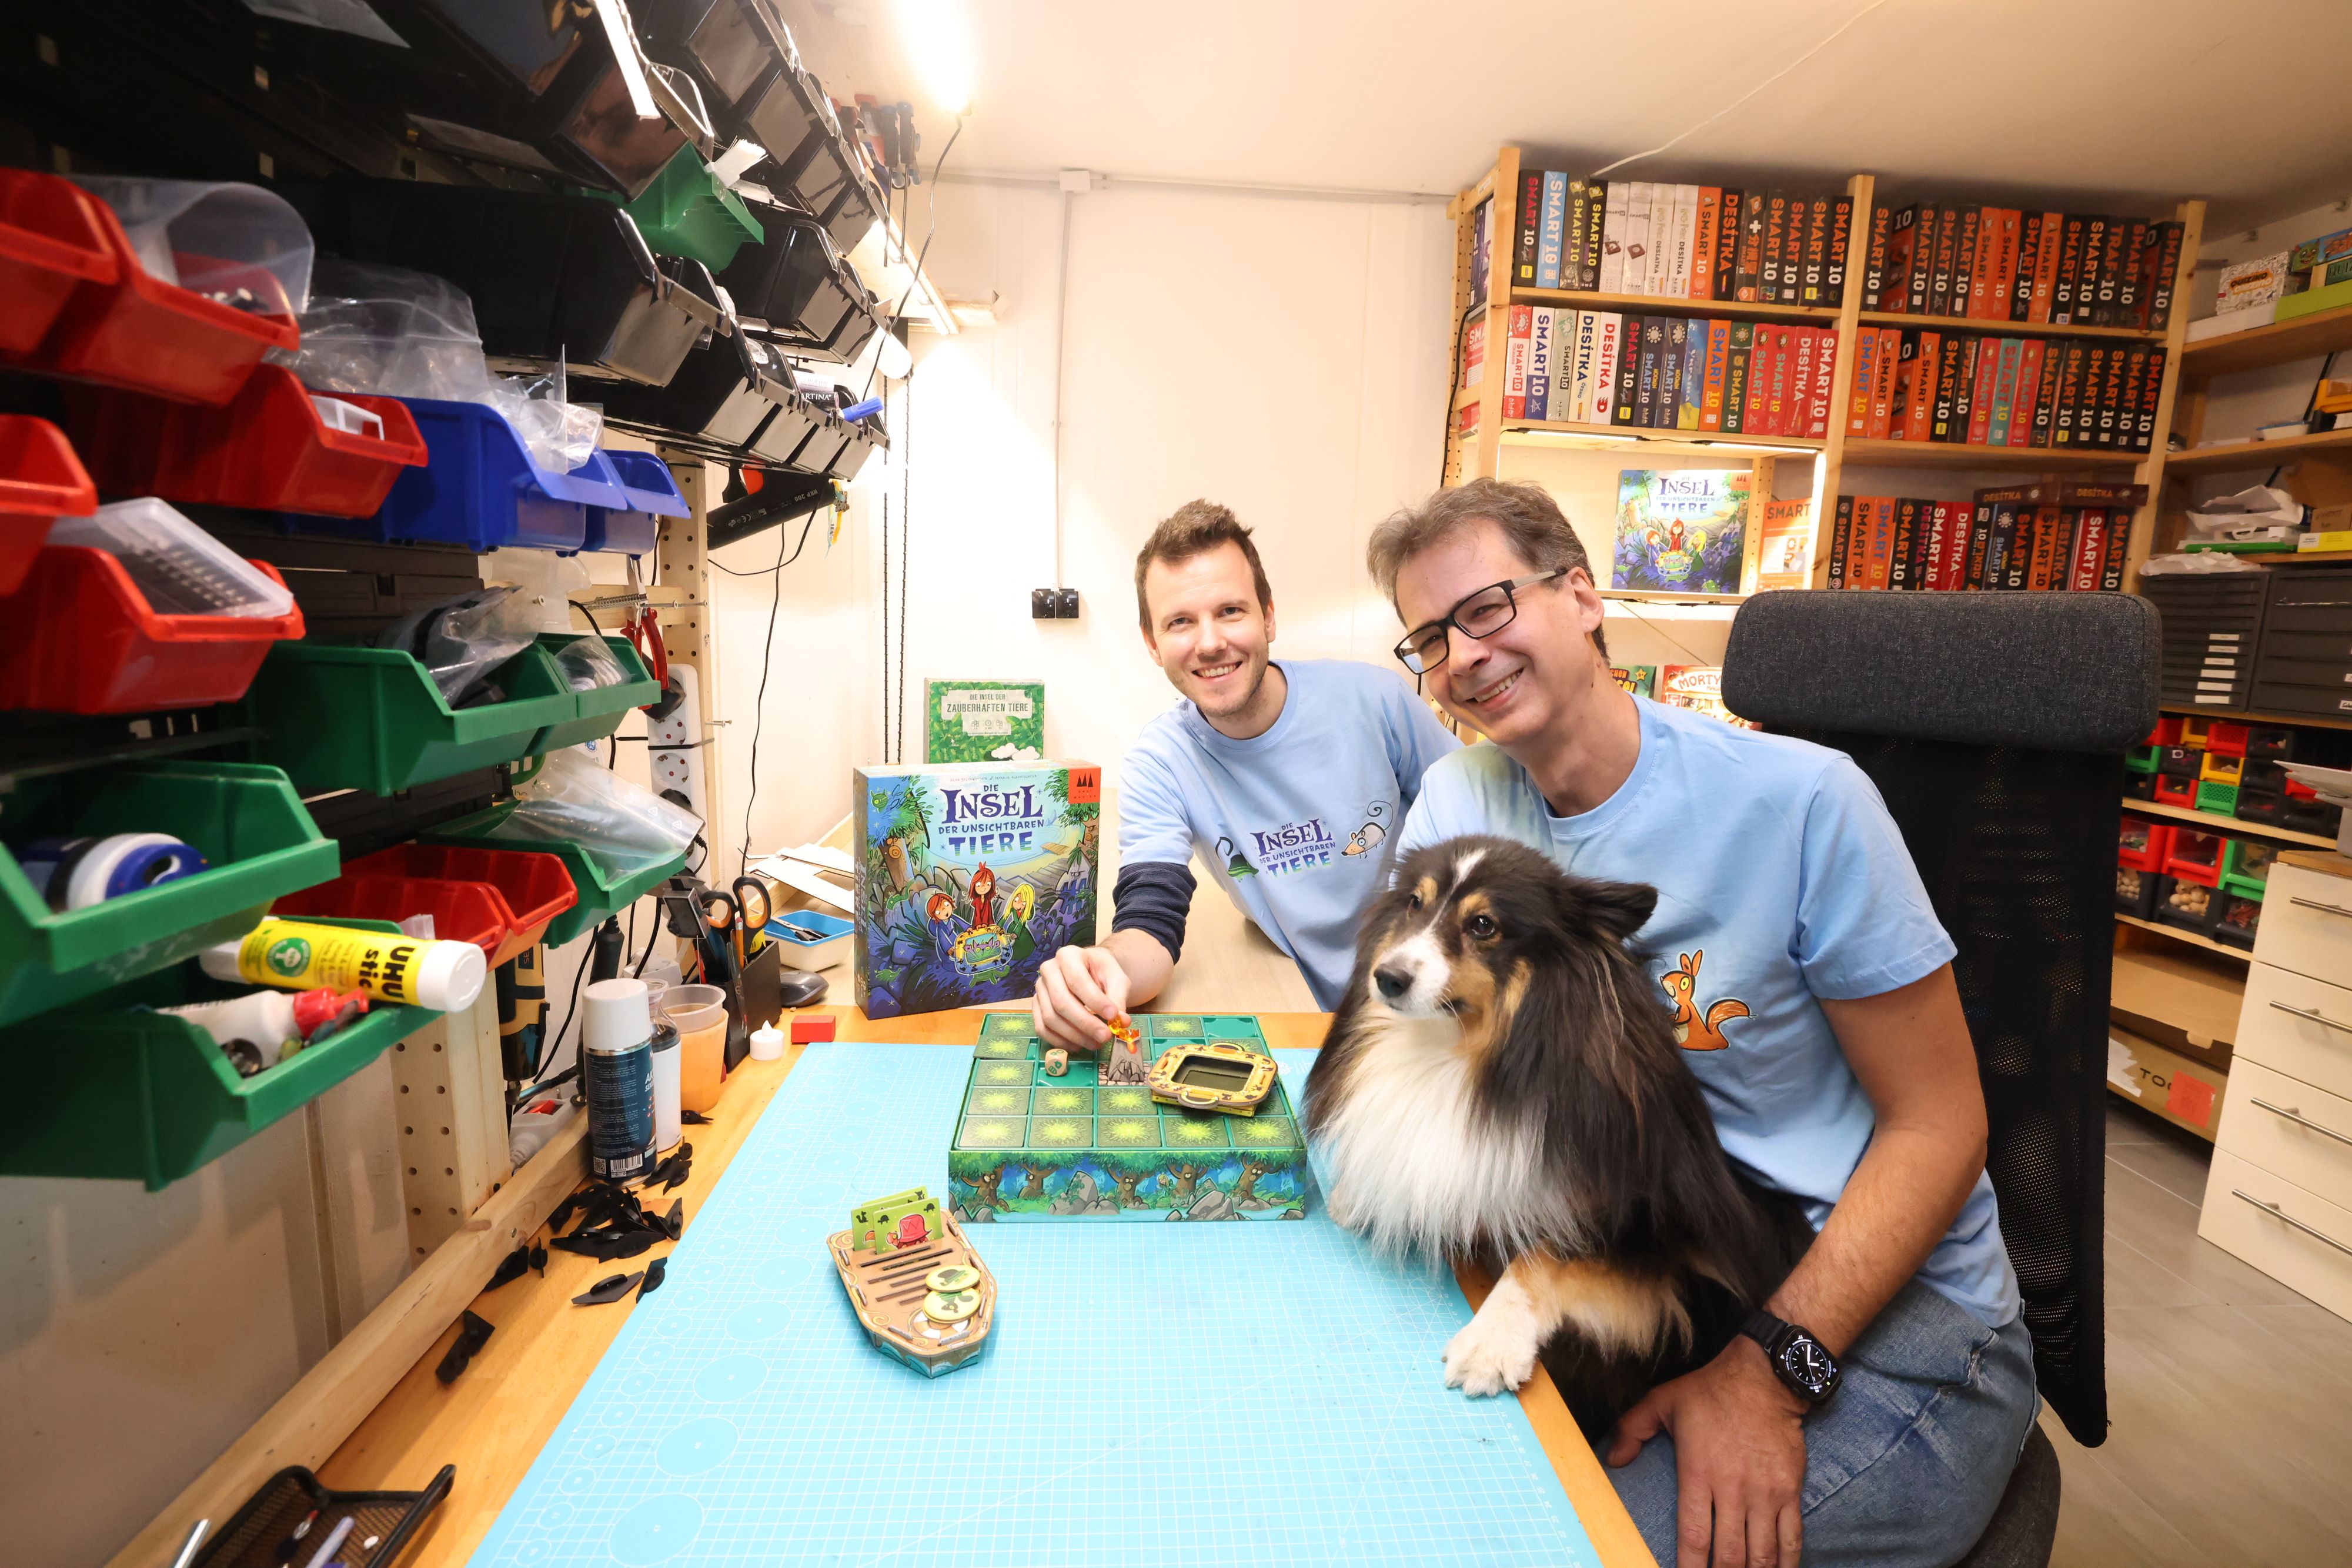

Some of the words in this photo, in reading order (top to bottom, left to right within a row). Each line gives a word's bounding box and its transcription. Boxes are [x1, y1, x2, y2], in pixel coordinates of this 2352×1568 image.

[1525, 178, 1538, 227] SMART
[1546, 180, 1562, 242] SMART
[1572, 198, 1583, 245] SMART
[1590, 203, 1602, 251] SMART
[1766, 198, 1785, 259] SMART
[1809, 202, 1826, 262] SMART
[1895, 209, 1912, 230] 10
[1524, 229, 1534, 245] 10
[1699, 211, 1711, 257] SMART
[1786, 202, 1805, 263] SMART
[1831, 203, 1849, 263] SMART
[1871, 208, 1889, 269] SMART
[1916, 209, 1935, 270] SMART
[1938, 210, 1956, 270] SMART
[1959, 212, 1977, 273] SMART
[1545, 245, 1558, 264] 10
[1570, 248, 1581, 262] 10
[1588, 252, 1598, 266] 10
[2022, 218, 2040, 278] SMART
[2061, 221, 2082, 281] SMART
[2084, 221, 2104, 282] SMART
[1696, 259, 1707, 273] 10
[1764, 262, 1778, 280] 10
[1783, 265, 1798, 284] 10
[1806, 265, 1820, 283] 10
[1828, 266, 1842, 285] 10
[1867, 271, 1881, 290] 10
[1913, 272, 1926, 290] 10
[1935, 273, 1948, 292] 10
[1956, 275, 1969, 293] 10
[2018, 280, 2032, 299] 10
[2058, 283, 2072, 302] 10
[2080, 283, 2094, 302] 10
[2099, 280, 2115, 301] 10
[1534, 315, 1549, 374] SMART
[1578, 316, 1594, 382] DESÍTKA
[1599, 323, 1615, 389] DESÍTKA
[1625, 322, 1640, 370] SMART
[1515, 343, 1524, 376] SMART
[1561, 346, 1571, 376] SMART
[1709, 329, 1726, 387] SMART
[1793, 337, 1811, 402] DESÍTKA
[1816, 337, 1835, 396] SMART
[1857, 336, 1874, 392] SMART
[1940, 340, 1958, 399] SMART
[1514, 377, 1523, 390] 10
[1561, 377, 1569, 389] 10
[1623, 373, 1634, 388] 10
[1643, 353, 1654, 390] SMART
[1665, 353, 1676, 391] SMART
[1752, 351, 1766, 396] SMART
[1772, 353, 1786, 398] SMART
[1877, 357, 1890, 400] SMART
[1917, 360, 1930, 403] SMART
[2040, 347, 2058, 405] SMART
[2063, 349, 2082, 406] SMART
[2083, 349, 2103, 406] SMART
[1532, 377, 1545, 396] 10
[1641, 392, 1649, 404] 10
[1663, 392, 1672, 404] 10
[1730, 370, 1742, 412] SMART
[1709, 392, 1720, 407] 10
[1752, 398, 1761, 410] 10
[1772, 400, 1780, 412] 10
[1813, 399, 1827, 417] 10
[1856, 398, 1867, 413] 10
[1876, 403, 1885, 417] 10
[1937, 401, 1950, 419] 10
[1957, 397, 1969, 414] 10
[1727, 414, 1737, 428] 10
[1915, 406, 1924, 419] 10
[2036, 407, 2049, 425] 10
[2059, 409, 2073, 427] 10
[2080, 409, 2093, 427] 10
[1658, 477, 1715, 496] INSEL
[1661, 503, 1708, 513] TIERE
[1834, 517, 1847, 559] SMART
[1853, 503, 1870, 559] SMART
[1873, 504, 1891, 560] SMART
[1896, 505, 1914, 561] SMART
[1927, 508, 1946, 563] SMART
[1949, 513, 1969, 572] DESÍTKA
[1977, 529, 1987, 540] 10
[2012, 514, 2030, 567] SMART
[2037, 514, 2054, 568] SMART
[2083, 516, 2102, 570] SMART
[1992, 537, 2004, 570] SMART
[1832, 562, 1842, 575] 10
[1853, 563, 1863, 577] 10
[1873, 564, 1883, 579] 10
[1893, 563, 1906, 580] 10
[1927, 567, 1938, 581] 10
[1990, 573, 1999, 583] 10
[2009, 570, 2022, 587] 10
[2036, 573, 2046, 586] 10
[2080, 572, 2093, 589] 10
[947, 703, 1005, 713] ZAUBERHAFTEN
[1008, 703, 1028, 712] TIERE
[940, 785, 1043, 824] INSEL
[938, 825, 957, 834] DER
[961, 820, 1044, 833] UNSICHTBAREN
[1250, 818, 1332, 857] INSEL
[948, 831, 1033, 856] TIERE
[1272, 842, 1335, 860] UNSICHTBAREN
[1267, 851, 1331, 877] TIERE
[358, 948, 379, 989] stic
[380, 945, 417, 999] UHU
